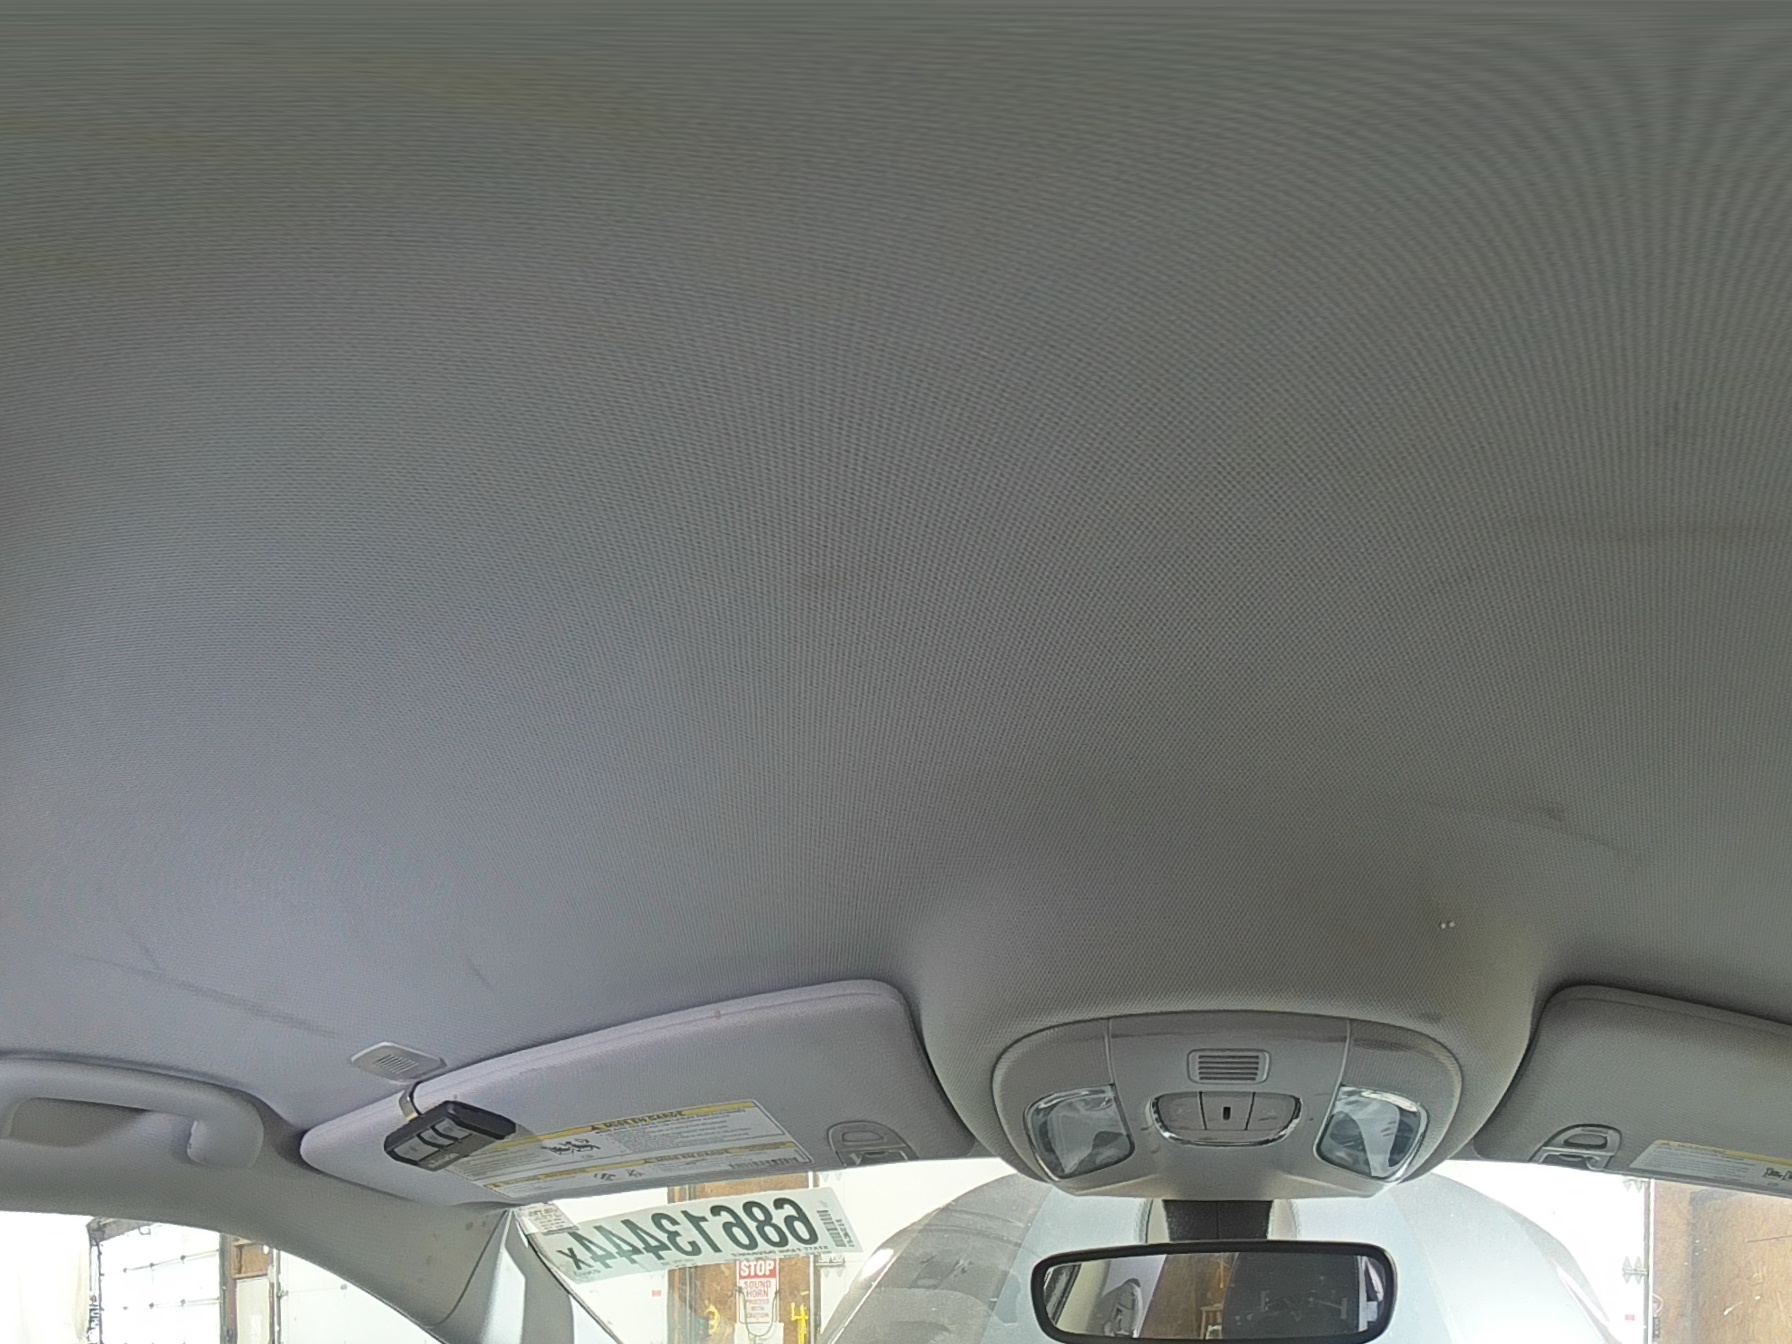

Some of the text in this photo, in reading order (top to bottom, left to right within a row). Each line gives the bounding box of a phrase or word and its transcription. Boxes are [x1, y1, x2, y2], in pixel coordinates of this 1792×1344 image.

[740, 1260, 775, 1277] STOP
[743, 1280, 771, 1289] SOUND
[746, 1289, 769, 1298] HORN
